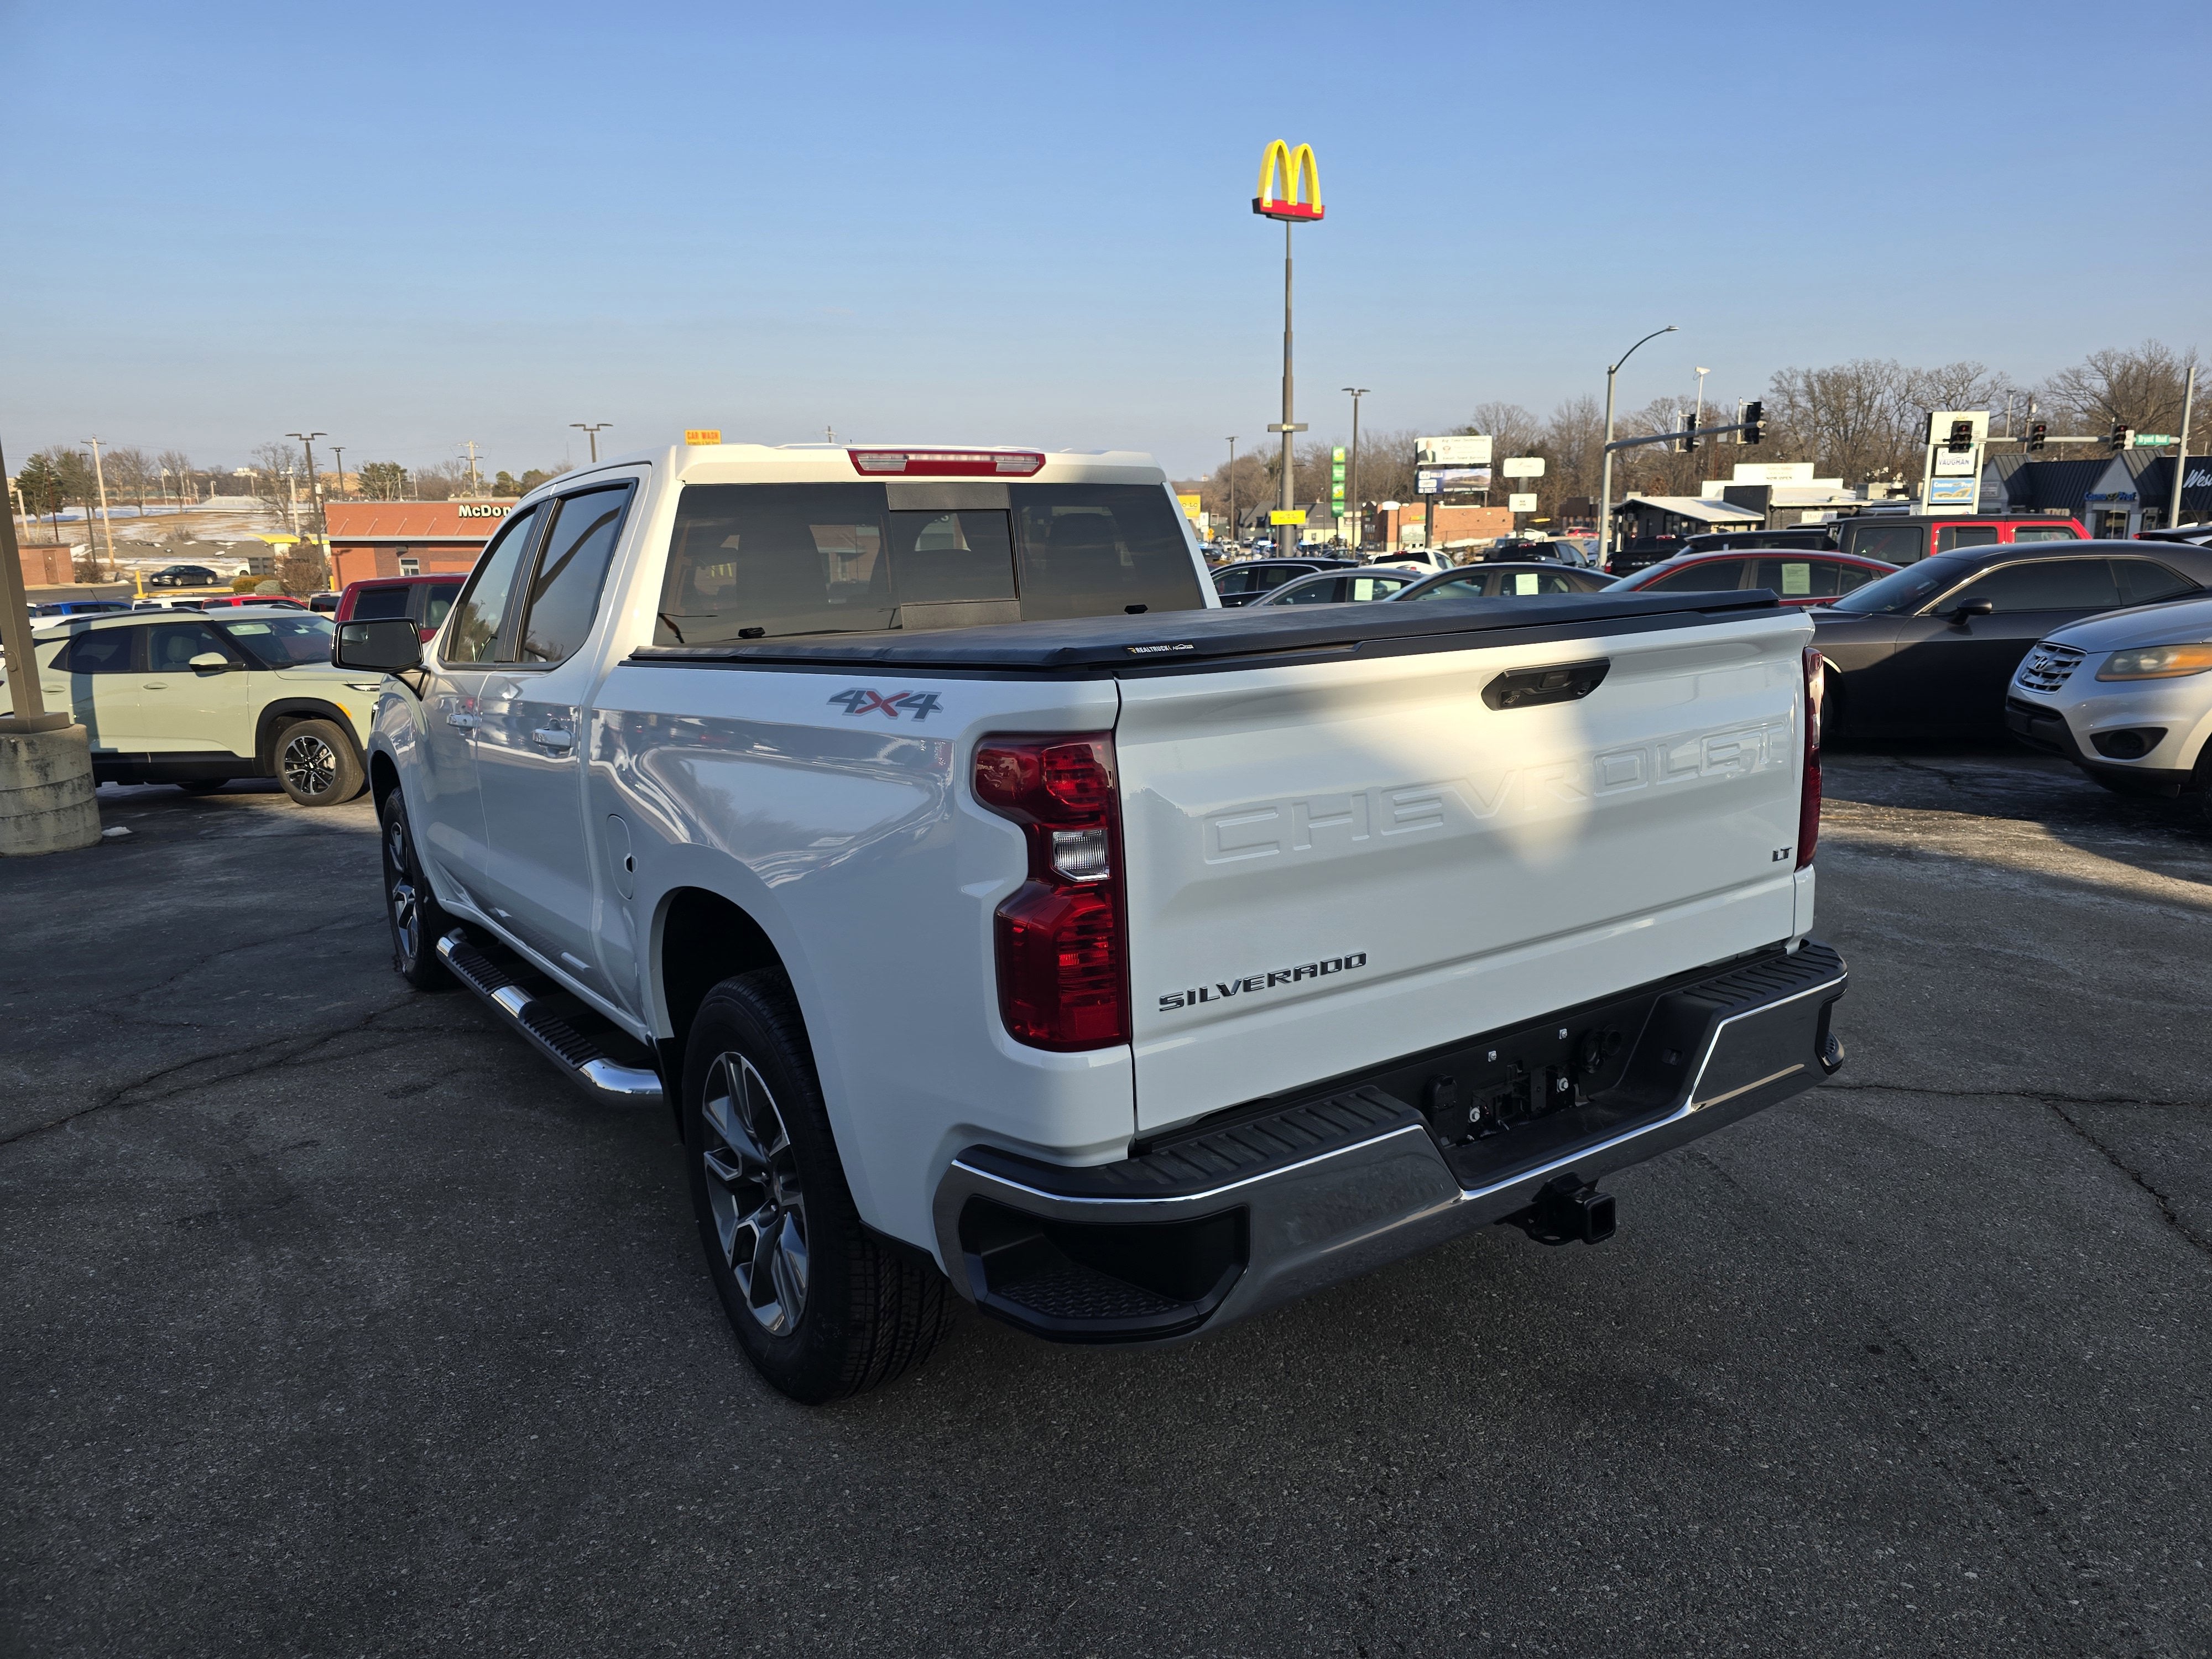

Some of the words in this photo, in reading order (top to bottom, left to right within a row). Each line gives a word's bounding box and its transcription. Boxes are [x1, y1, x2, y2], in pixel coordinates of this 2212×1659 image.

[1135, 645, 1168, 653] REALTRUCK
[1203, 719, 1785, 864] CHEVROLET
[1772, 845, 1793, 862] LT
[1159, 951, 1367, 1011] SILVERADO
